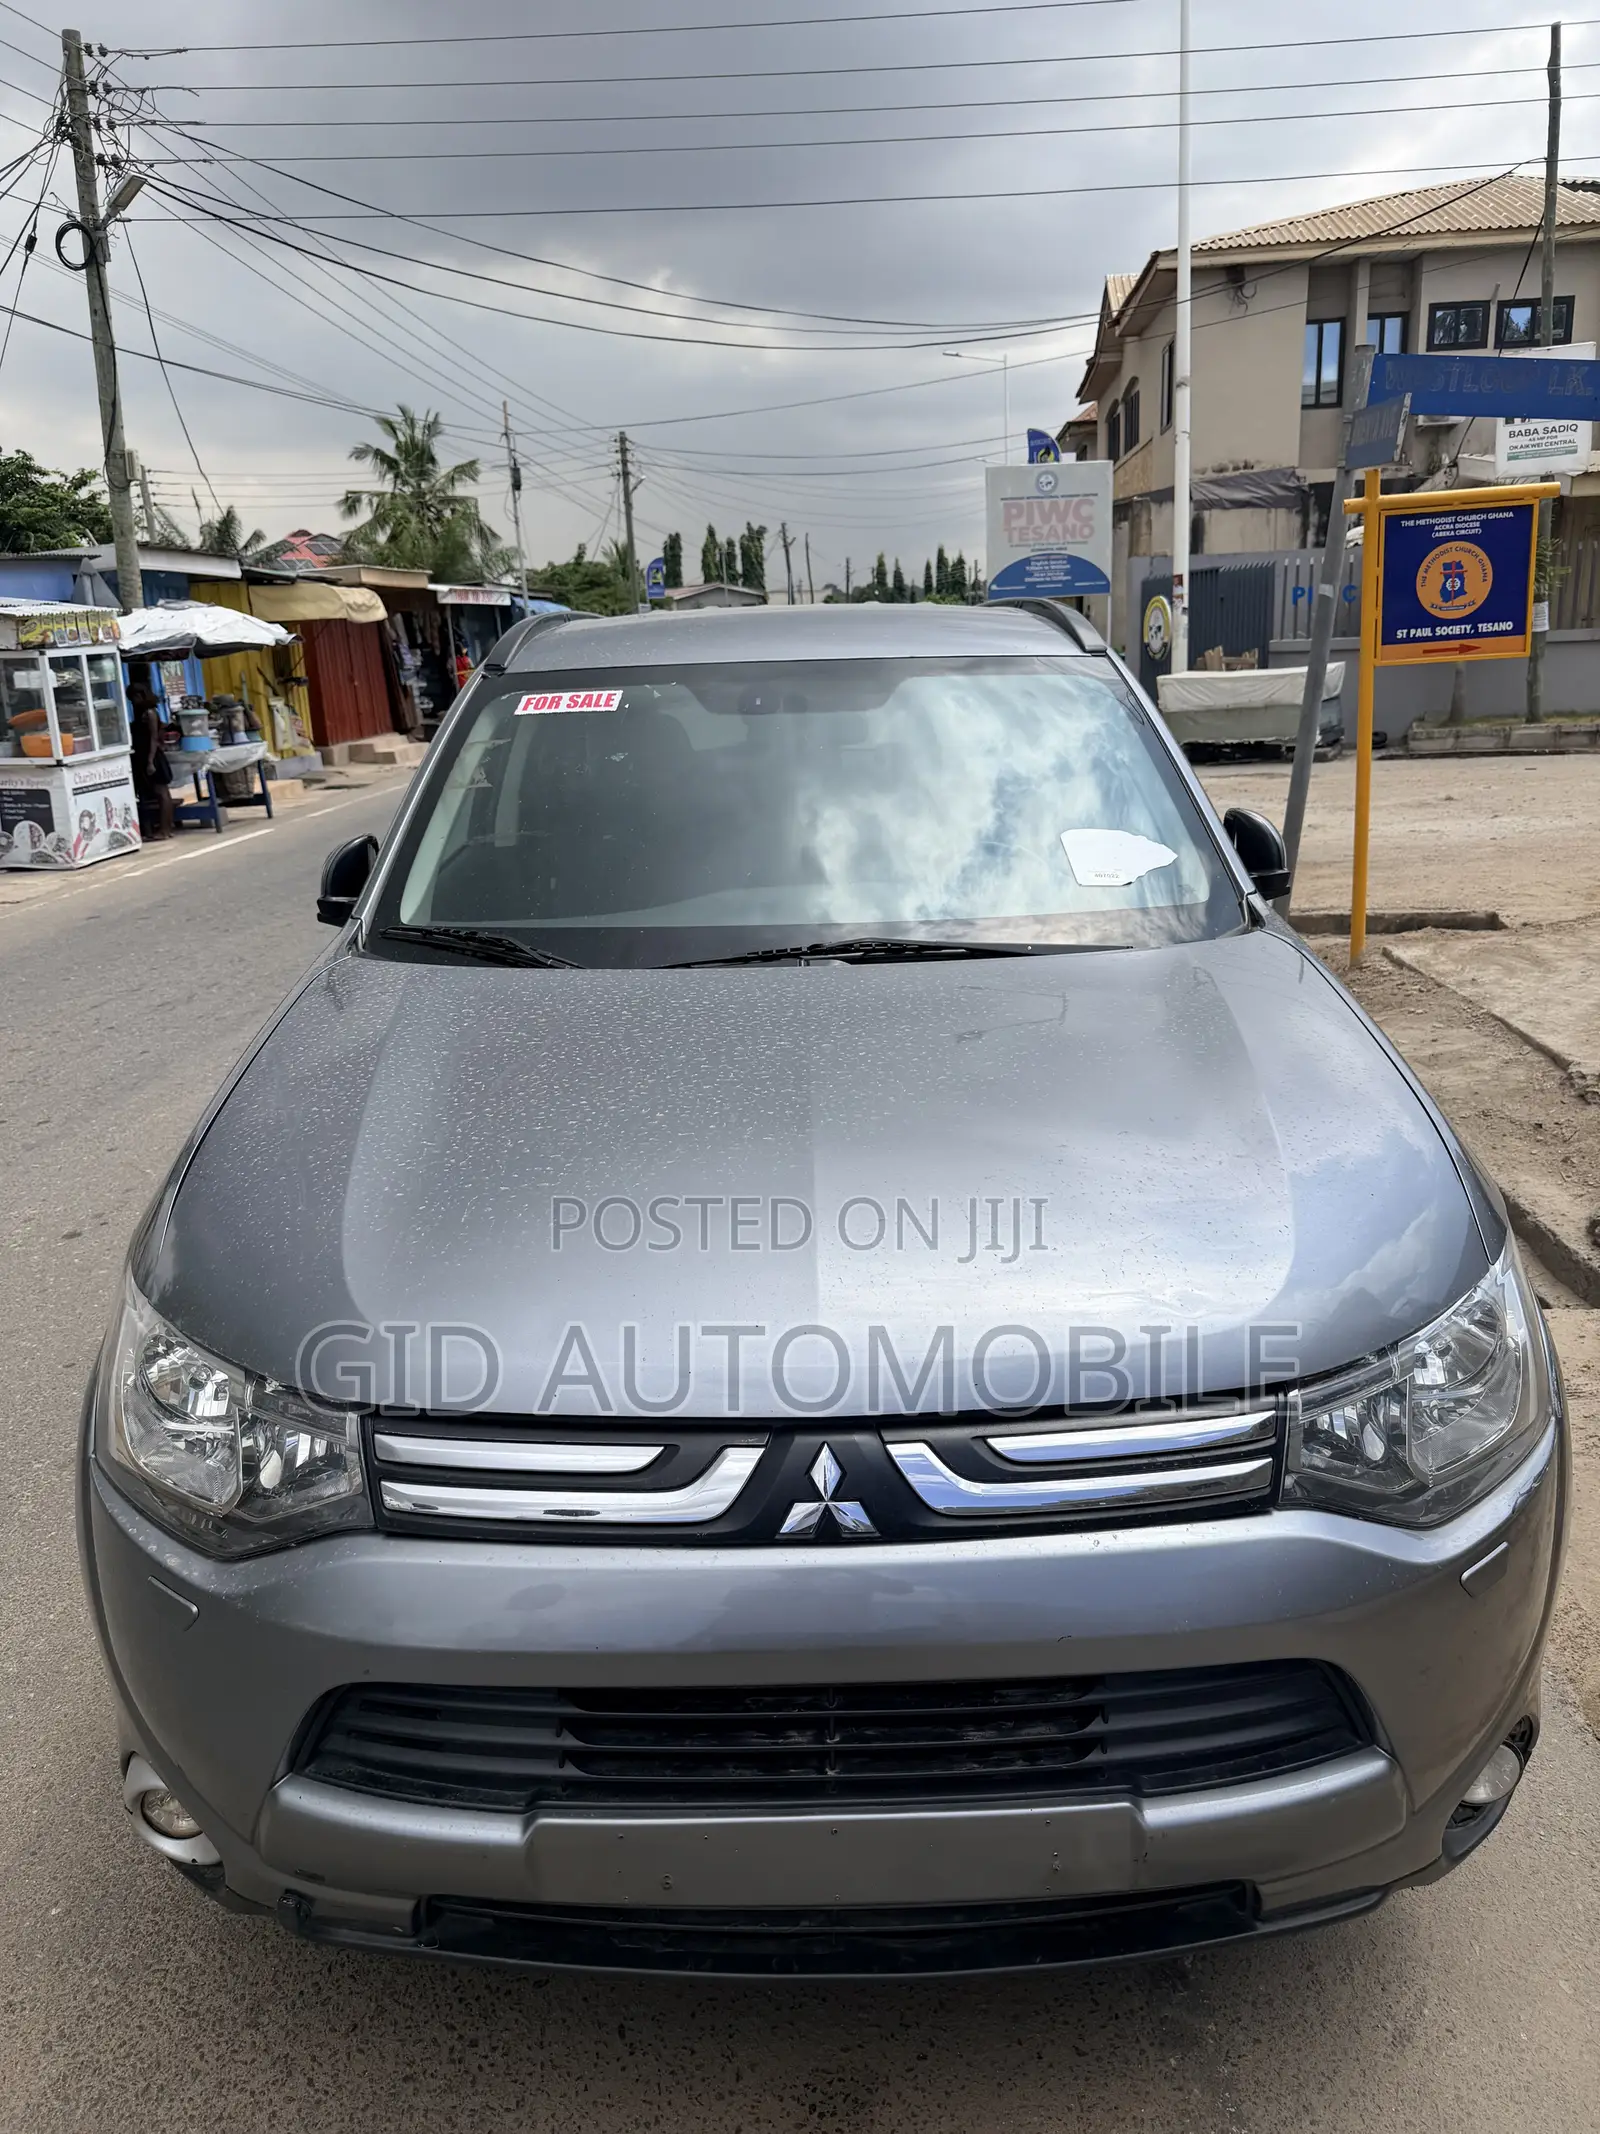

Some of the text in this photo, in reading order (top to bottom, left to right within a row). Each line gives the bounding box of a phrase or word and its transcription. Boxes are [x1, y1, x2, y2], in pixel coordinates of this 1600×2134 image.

[1508, 423, 1579, 439] BABA SADIQ
[1508, 438, 1577, 451] OKAIKWEI CENTRAL
[1003, 498, 1095, 527] PIWC
[1415, 516, 1456, 526] METHODIST
[1457, 513, 1487, 522] CHURCH
[1488, 511, 1514, 519] GHANA
[1004, 523, 1095, 543] TESANO
[1431, 528, 1482, 538] (ABEKA CIRCUIT)
[1434, 521, 1481, 531] ACCRA DIOCESE
[1423, 547, 1453, 574] METHODIST
[1454, 546, 1480, 559] CHURCH
[1478, 557, 1488, 583] GHANA
[1292, 584, 1357, 606] PIC
[1396, 621, 1514, 639] ST PAUL SOCIETY, TESANO
[521, 693, 617, 711] FOR SALE
[74, 770, 102, 785] Charity's
